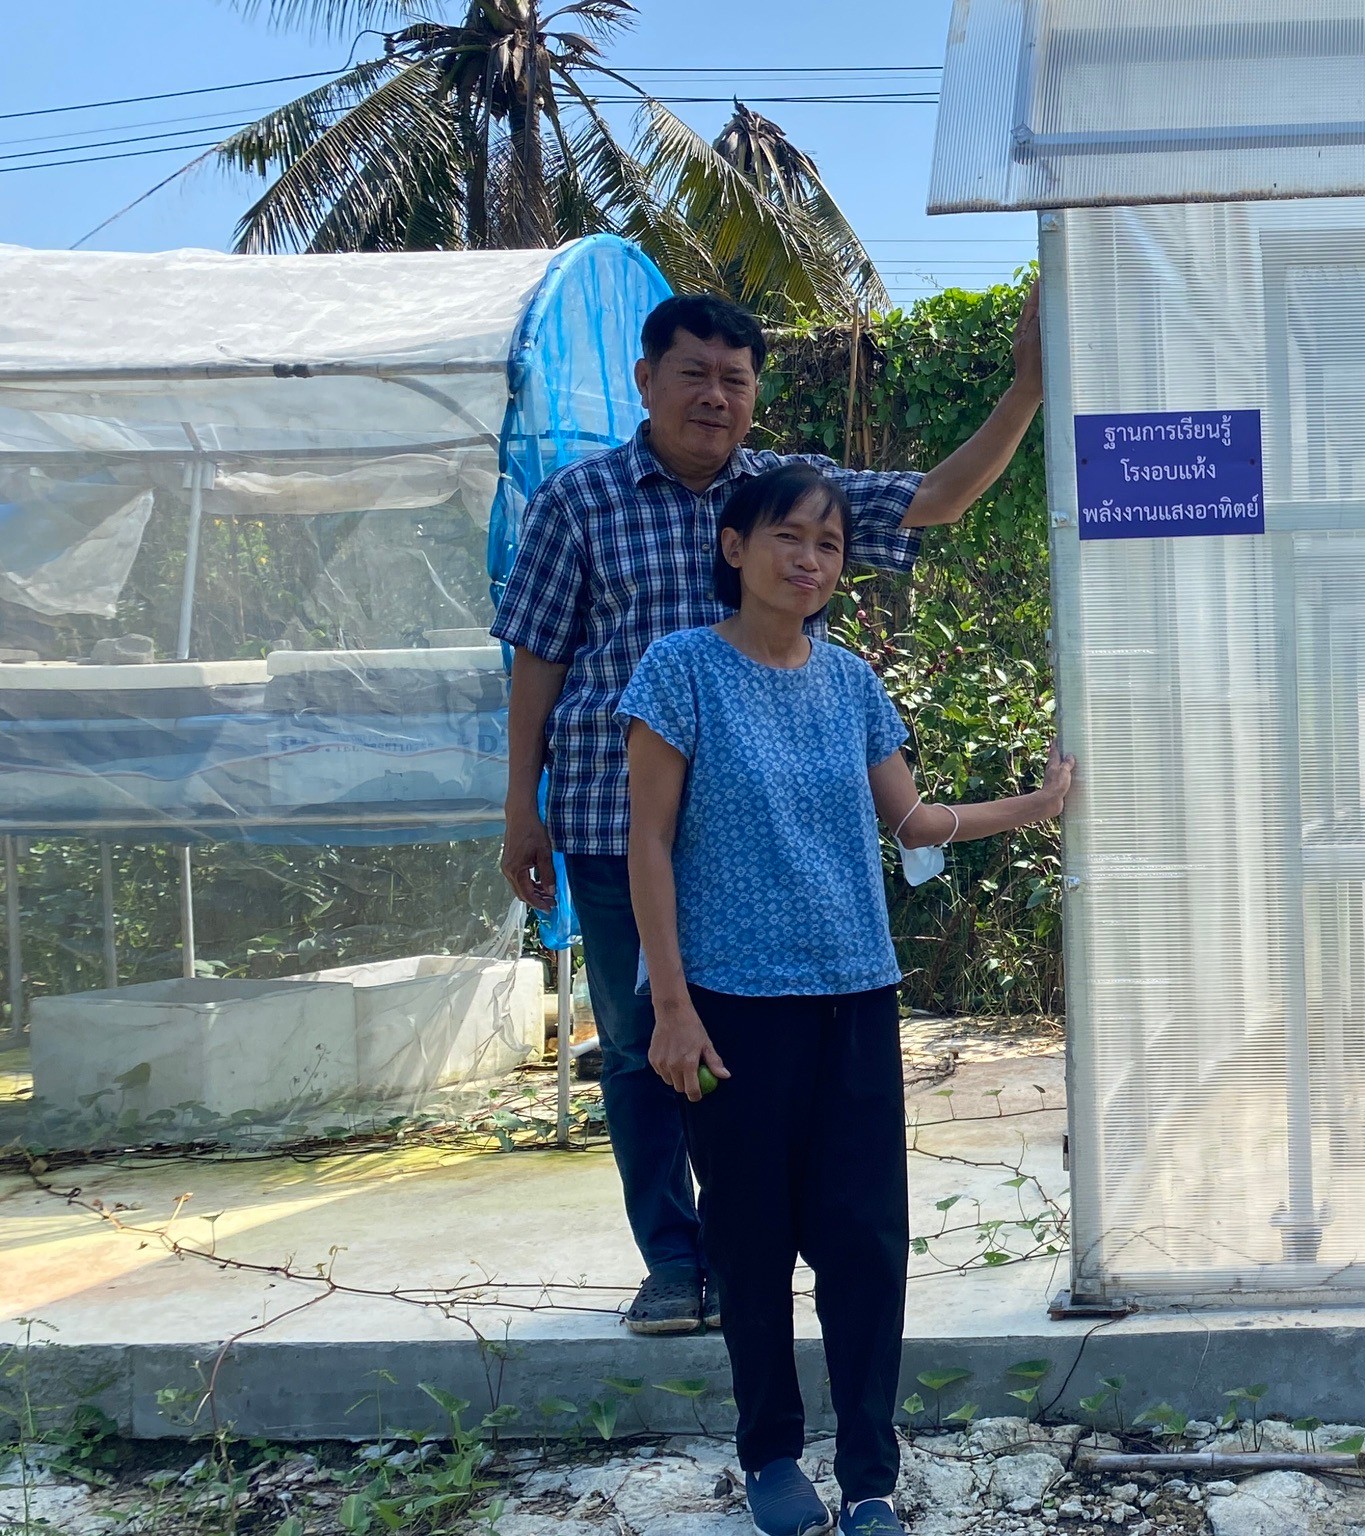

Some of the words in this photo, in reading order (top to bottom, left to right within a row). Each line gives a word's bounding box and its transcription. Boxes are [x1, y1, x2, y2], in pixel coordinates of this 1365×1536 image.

[1103, 414, 1232, 450] ฐานการเรียนรู้
[1120, 455, 1217, 482] โรงอบแห้ง
[1082, 493, 1259, 523] พลังงานแสงอาทิตย์
